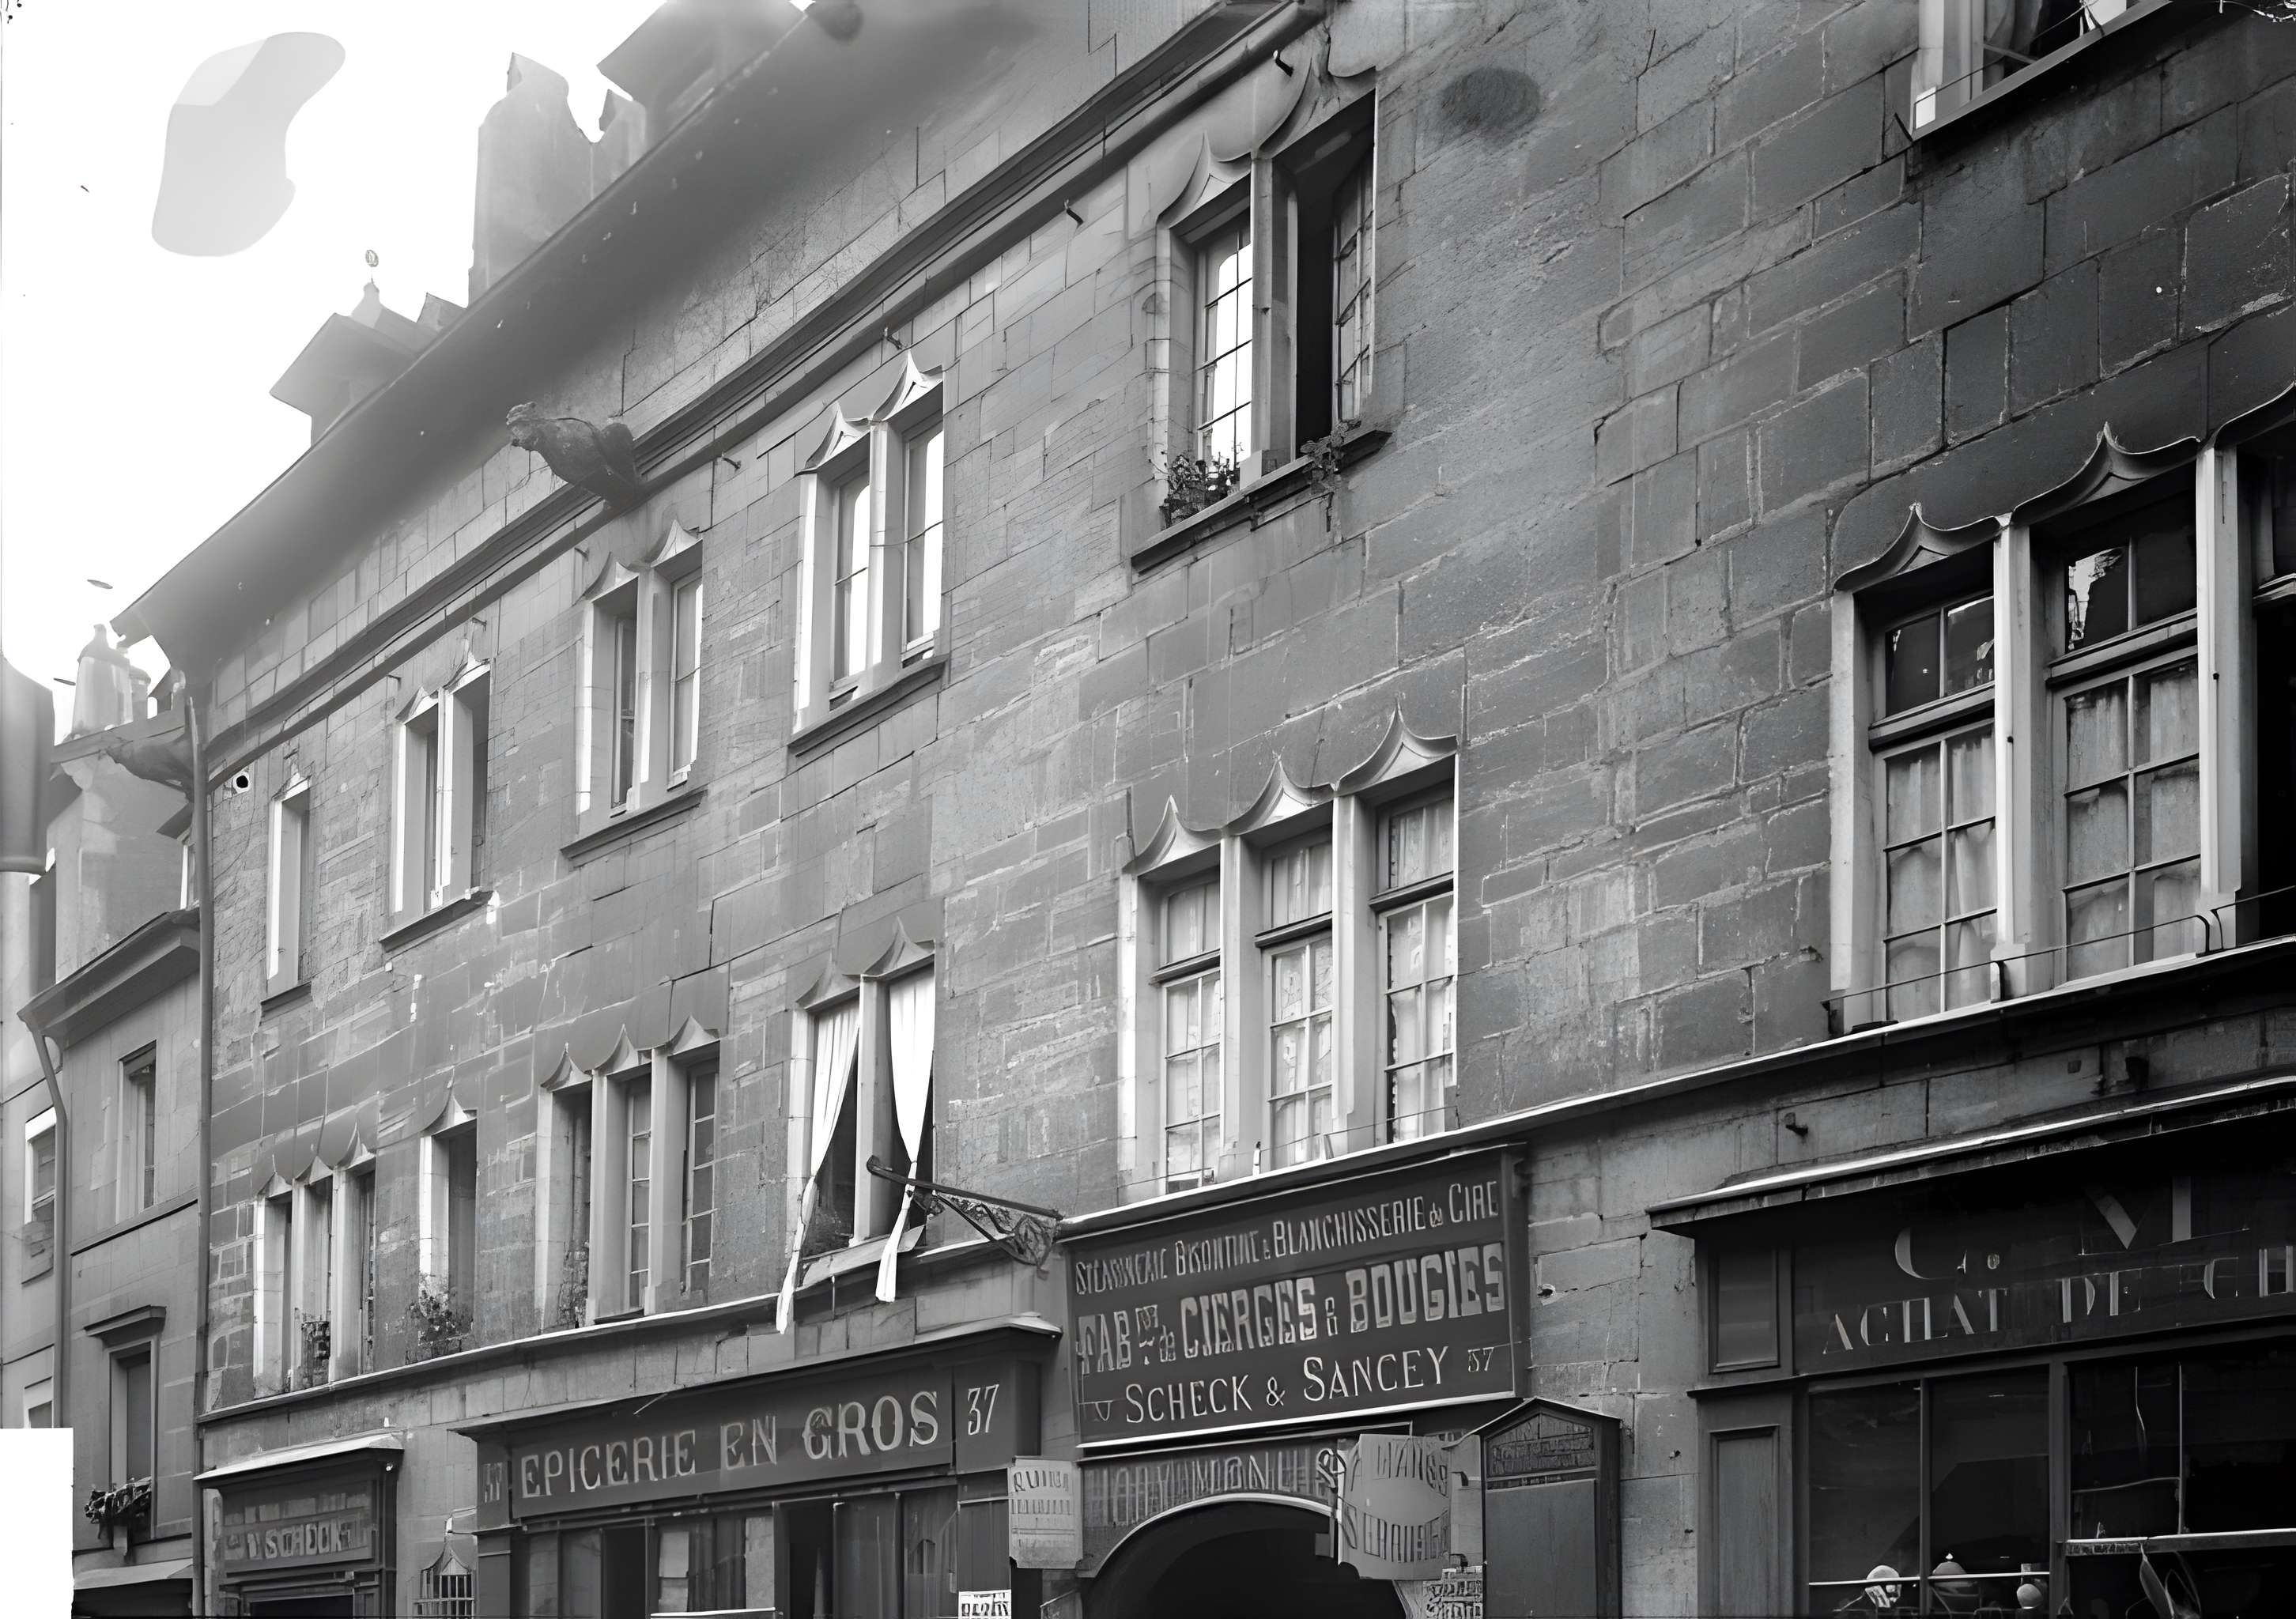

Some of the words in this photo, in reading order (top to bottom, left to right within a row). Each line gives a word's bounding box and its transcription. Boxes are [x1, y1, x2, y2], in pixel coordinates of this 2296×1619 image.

[1346, 1241, 1505, 1334] BOUGIES
[1822, 1287, 2009, 1356] ACHAT
[966, 1383, 1000, 1436] 37
[1125, 1374, 1252, 1424] SCHECK
[1266, 1376, 1285, 1407] &
[1303, 1345, 1449, 1402] SANCEY
[720, 1415, 777, 1471] EN
[802, 1391, 939, 1460] GROS
